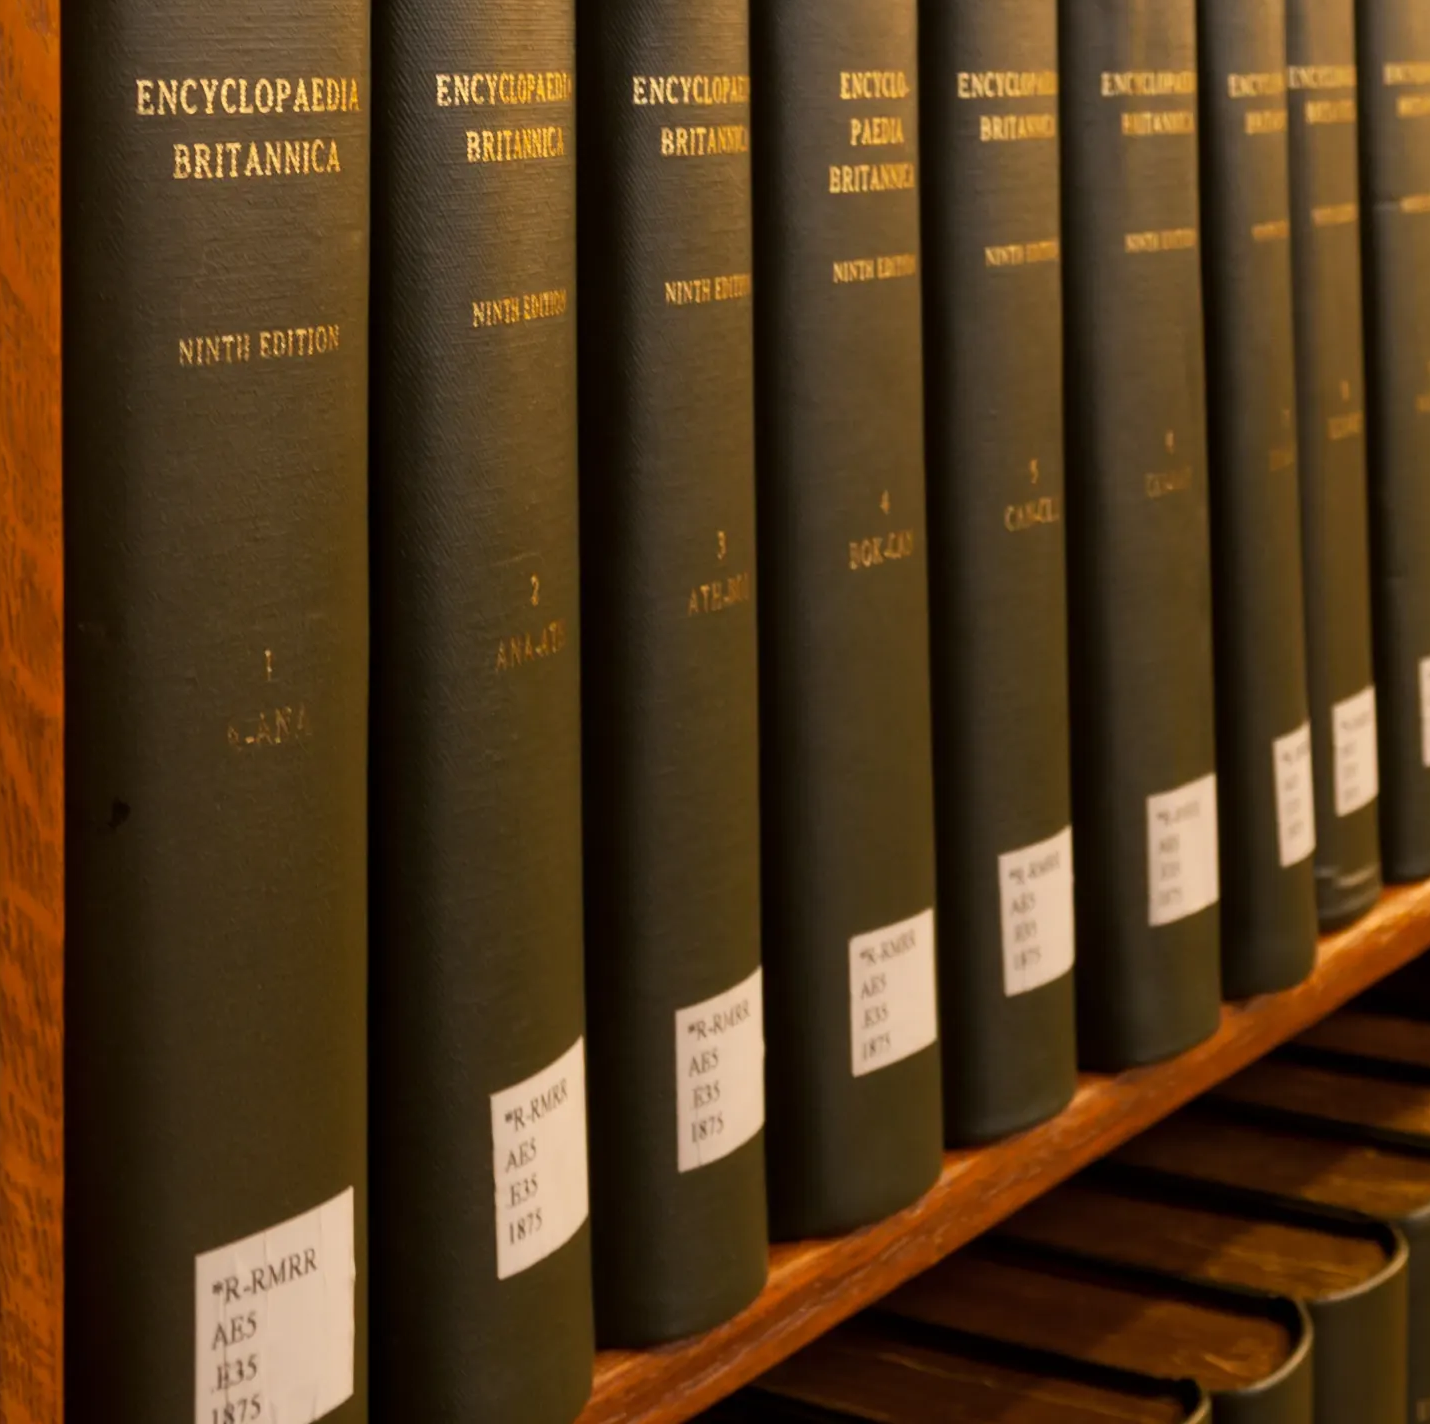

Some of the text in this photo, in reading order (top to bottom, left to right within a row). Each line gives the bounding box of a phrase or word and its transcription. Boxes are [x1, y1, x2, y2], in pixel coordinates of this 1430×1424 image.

[135, 76, 361, 118] ENCYCLOPAEDIA
[465, 126, 565, 163] BRITANNICA
[849, 116, 905, 147] PAEDIA
[172, 138, 343, 180] BRITANNICA
[832, 258, 875, 284] NINTH
[664, 278, 711, 306] NINTH
[472, 295, 521, 328] NINTH
[178, 323, 341, 368] NINTH EDITION
[688, 1047, 720, 1079] AE5
[691, 1109, 725, 1145] 1875
[505, 1136, 538, 1175] AE5
[508, 1206, 544, 1247] 1875
[211, 1310, 258, 1352] AE5
[211, 1393, 262, 1424] 1875
